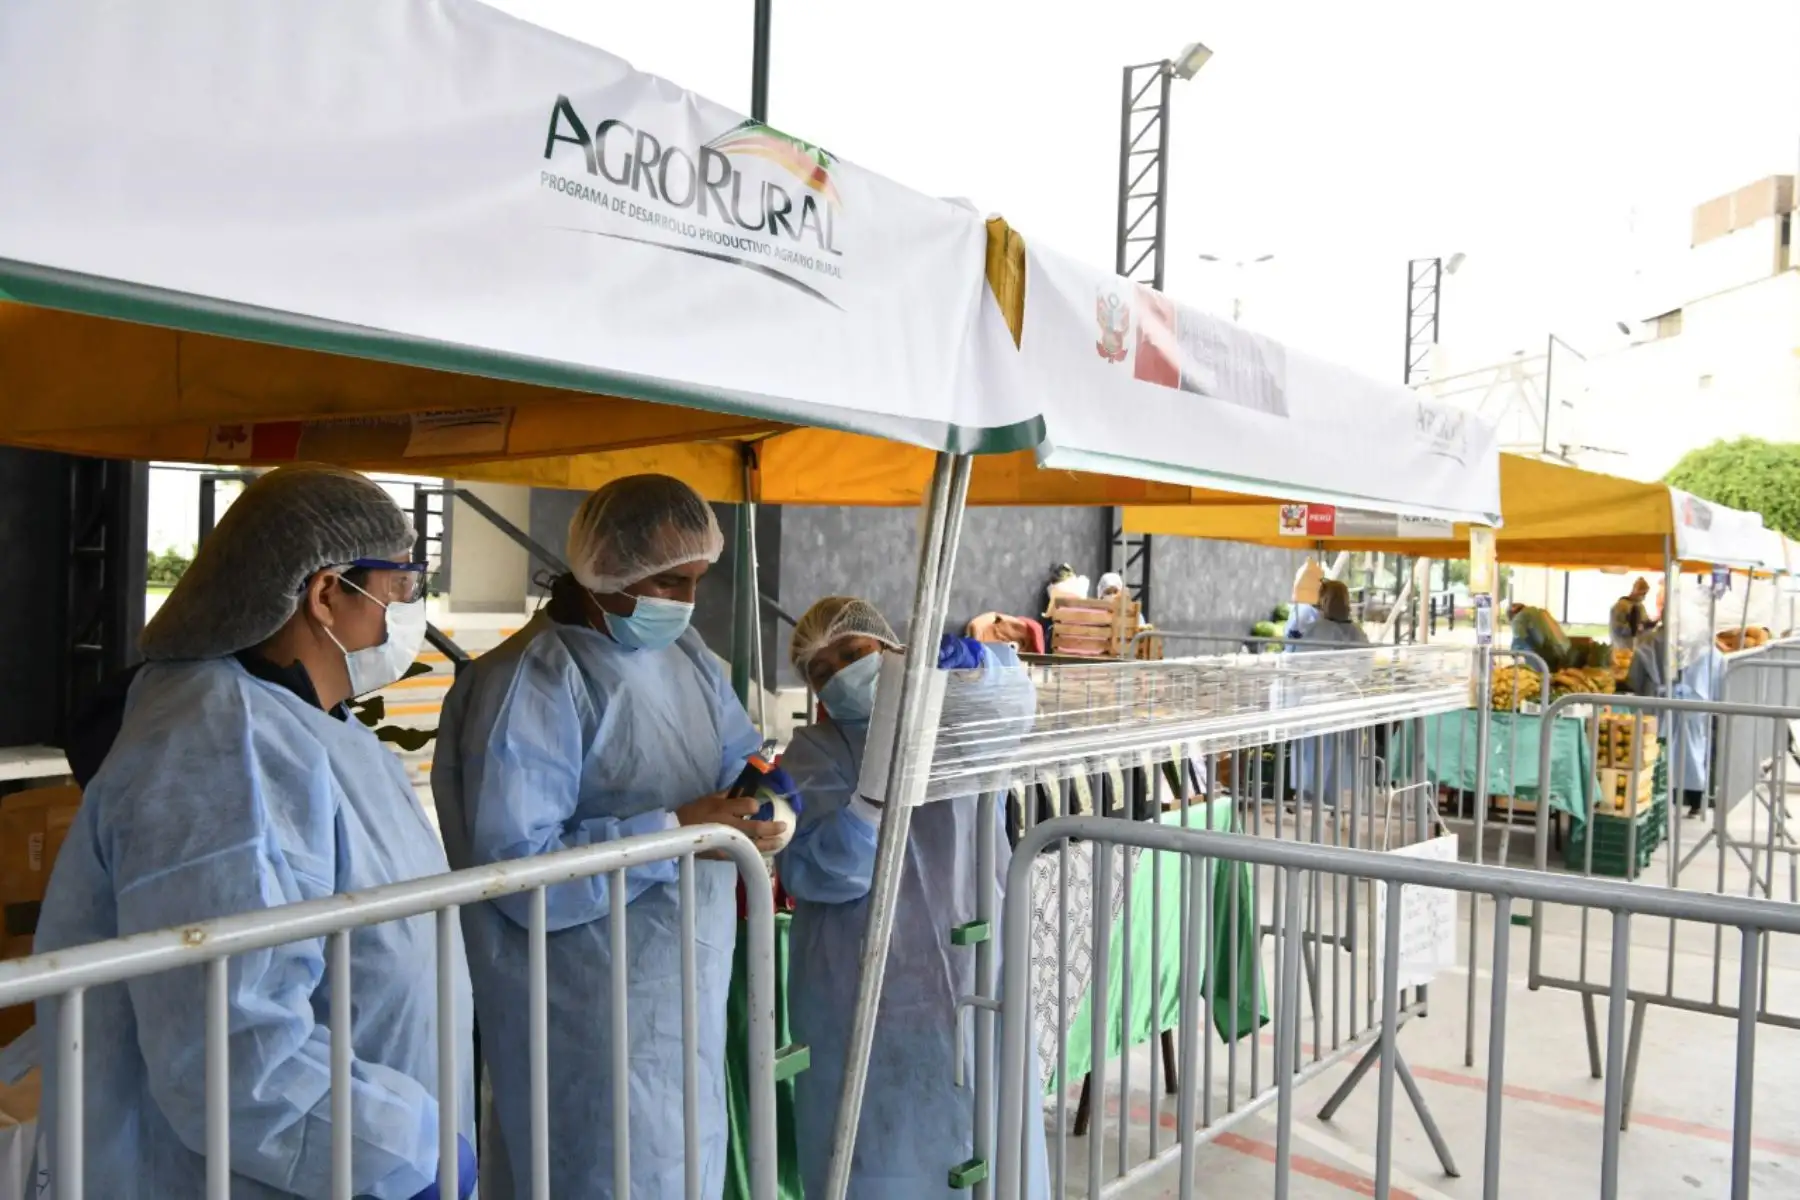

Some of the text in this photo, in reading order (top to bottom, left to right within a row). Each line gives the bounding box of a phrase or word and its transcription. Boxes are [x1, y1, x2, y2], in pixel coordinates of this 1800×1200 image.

[540, 171, 843, 279] PROGRAMA DE DESARROLLO PRODUCTIVO AGRARIO RURAL
[544, 93, 842, 256] AGRORURAL
